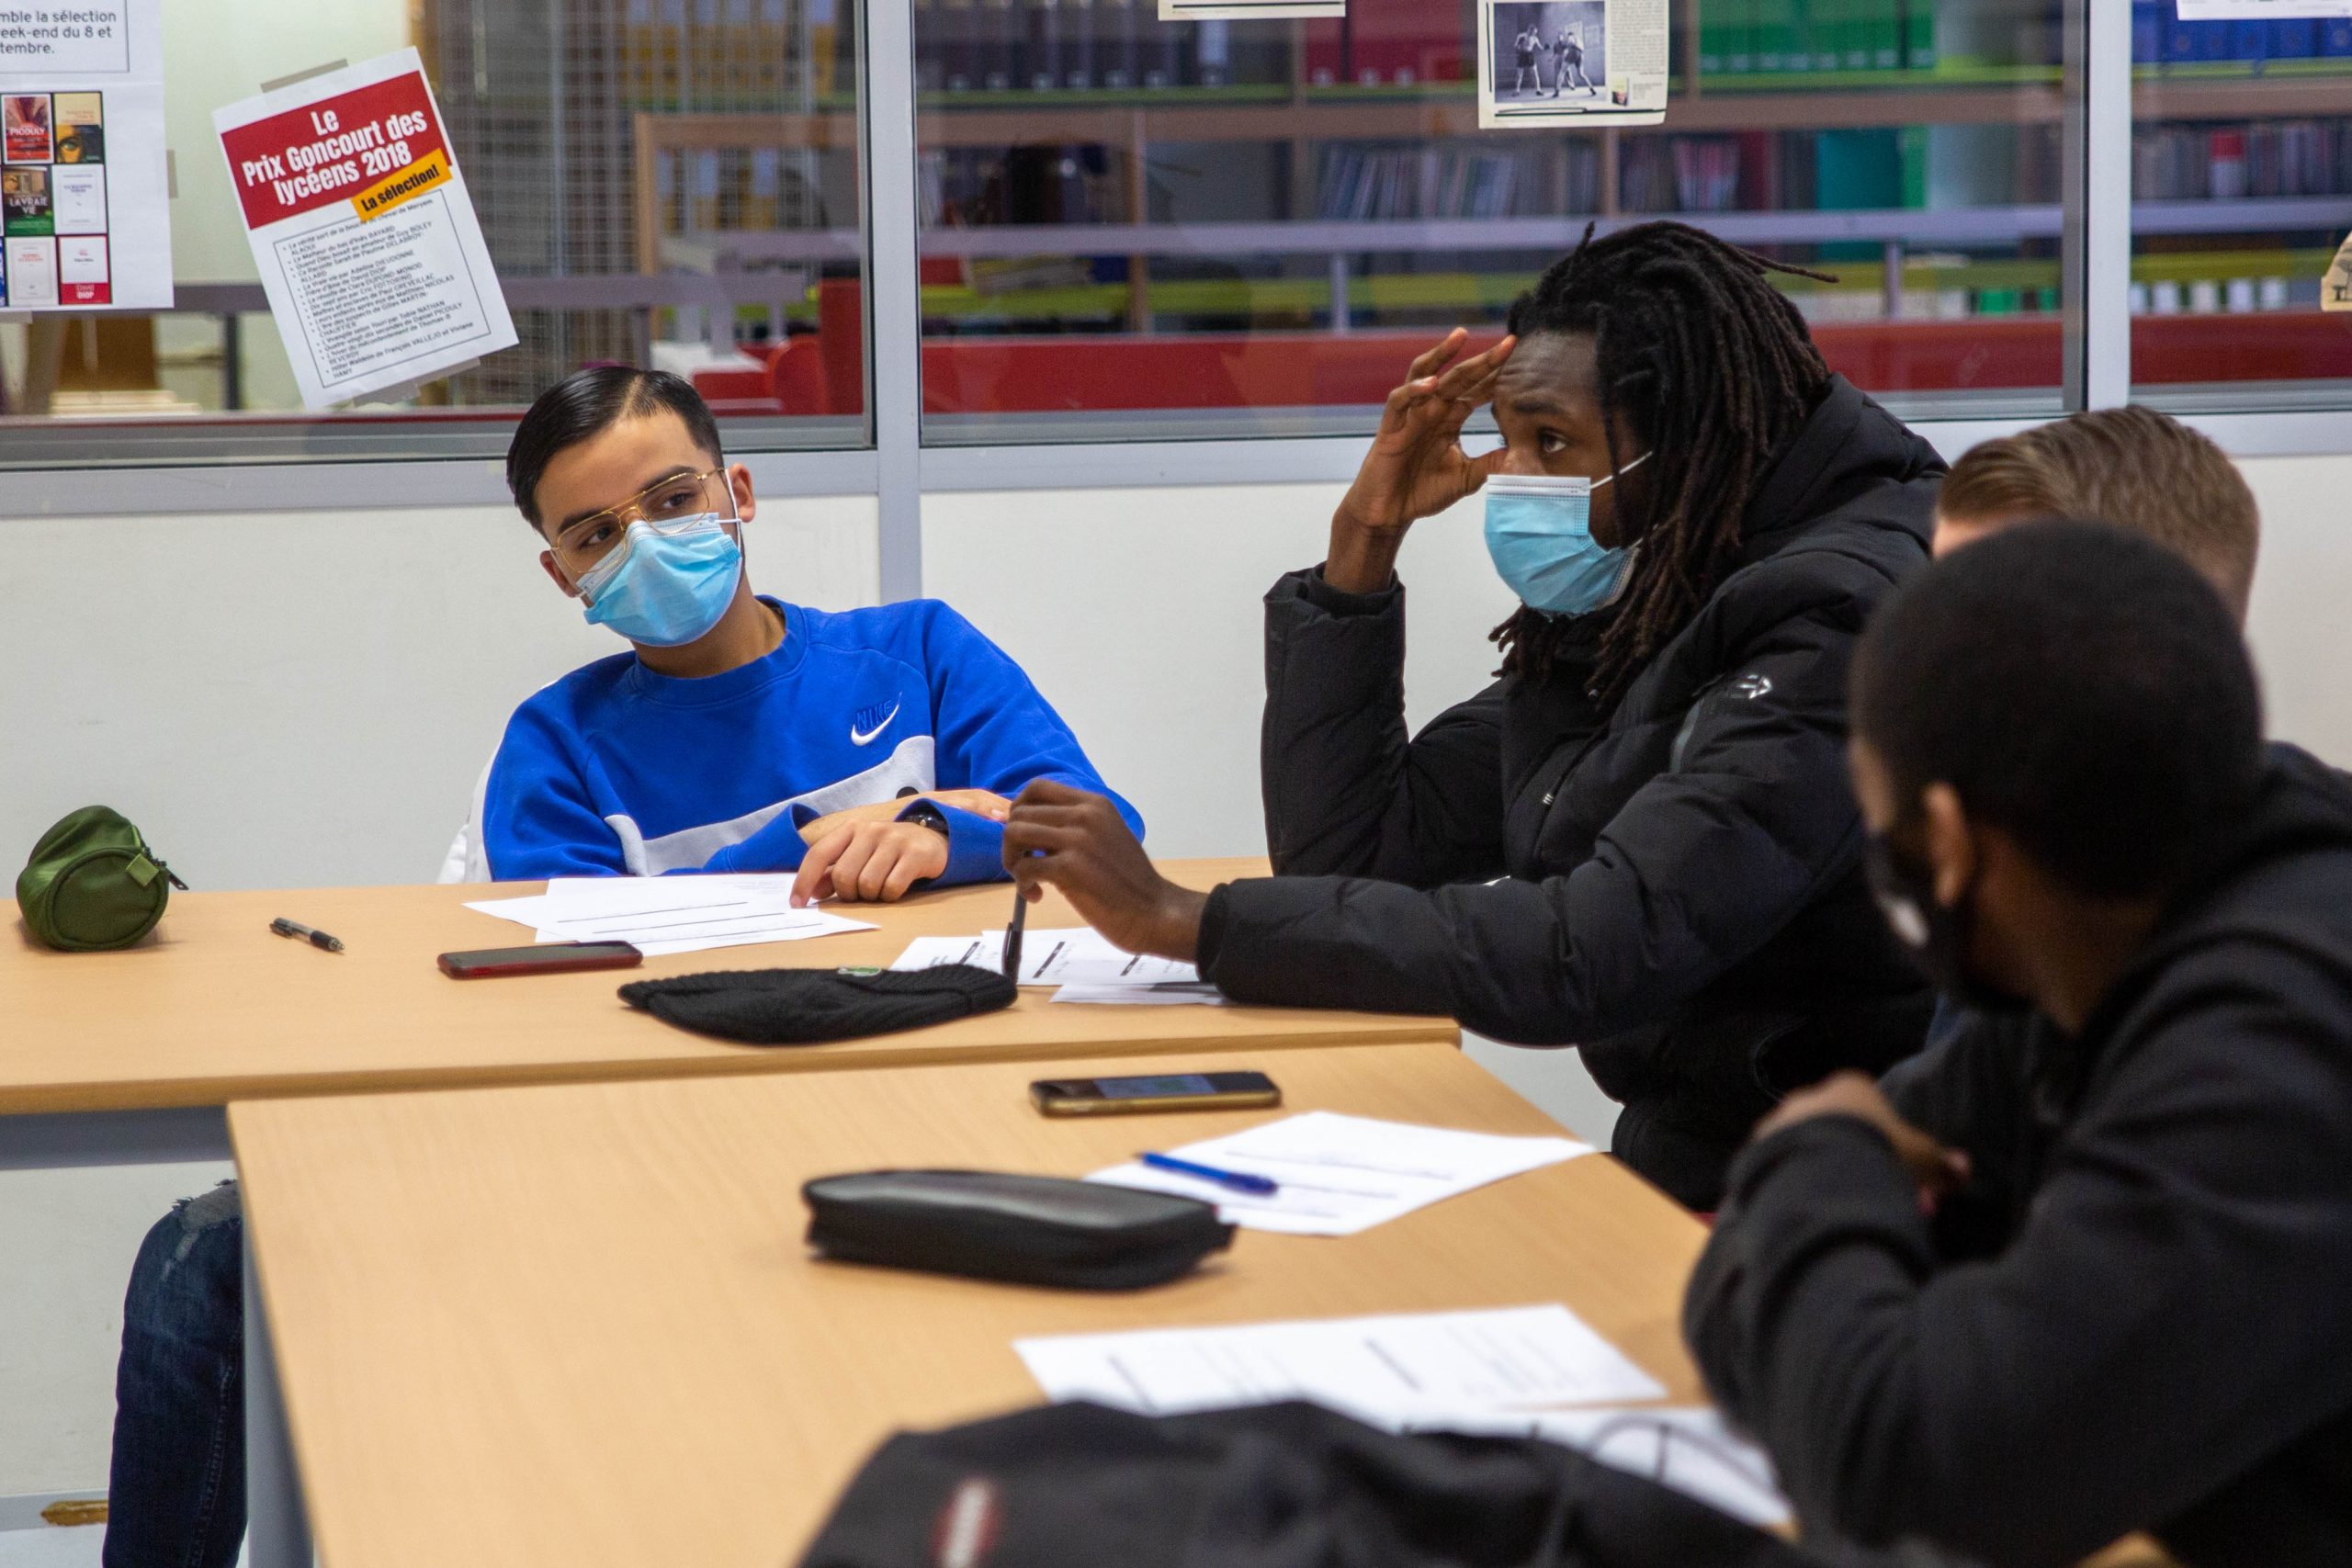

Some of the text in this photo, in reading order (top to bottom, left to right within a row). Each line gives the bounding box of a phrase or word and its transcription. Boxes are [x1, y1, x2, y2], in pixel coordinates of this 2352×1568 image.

[37, 11, 48, 23] la
[52, 10, 117, 23] sélection
[0, 26, 112, 39] eek-end du 8 et
[311, 109, 339, 136] Le
[242, 110, 427, 186] Prix Goncourt des
[273, 141, 412, 206] lycéens 2018
[361, 164, 439, 212] La sélection!
[856, 700, 892, 731] NIKE
